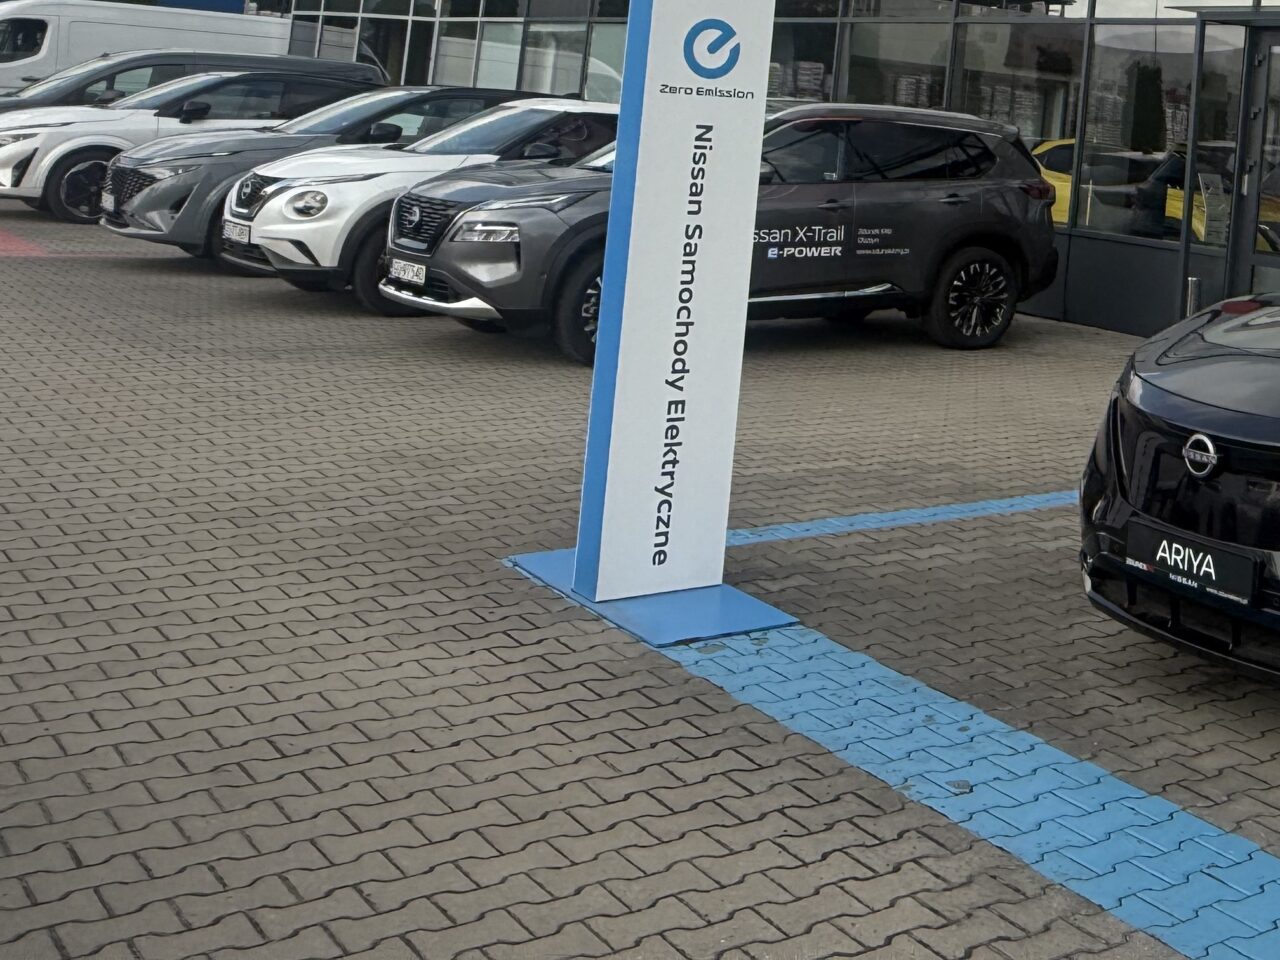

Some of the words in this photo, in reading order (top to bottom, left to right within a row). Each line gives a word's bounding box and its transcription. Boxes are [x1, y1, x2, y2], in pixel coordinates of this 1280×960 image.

[659, 84, 693, 96] Zero
[696, 86, 754, 100] Emission
[687, 124, 714, 216] Nissan
[794, 225, 845, 242] X-Trail
[664, 224, 704, 392] Samochody
[652, 399, 686, 566] Elektryczne
[1156, 539, 1216, 581] ARIYA
